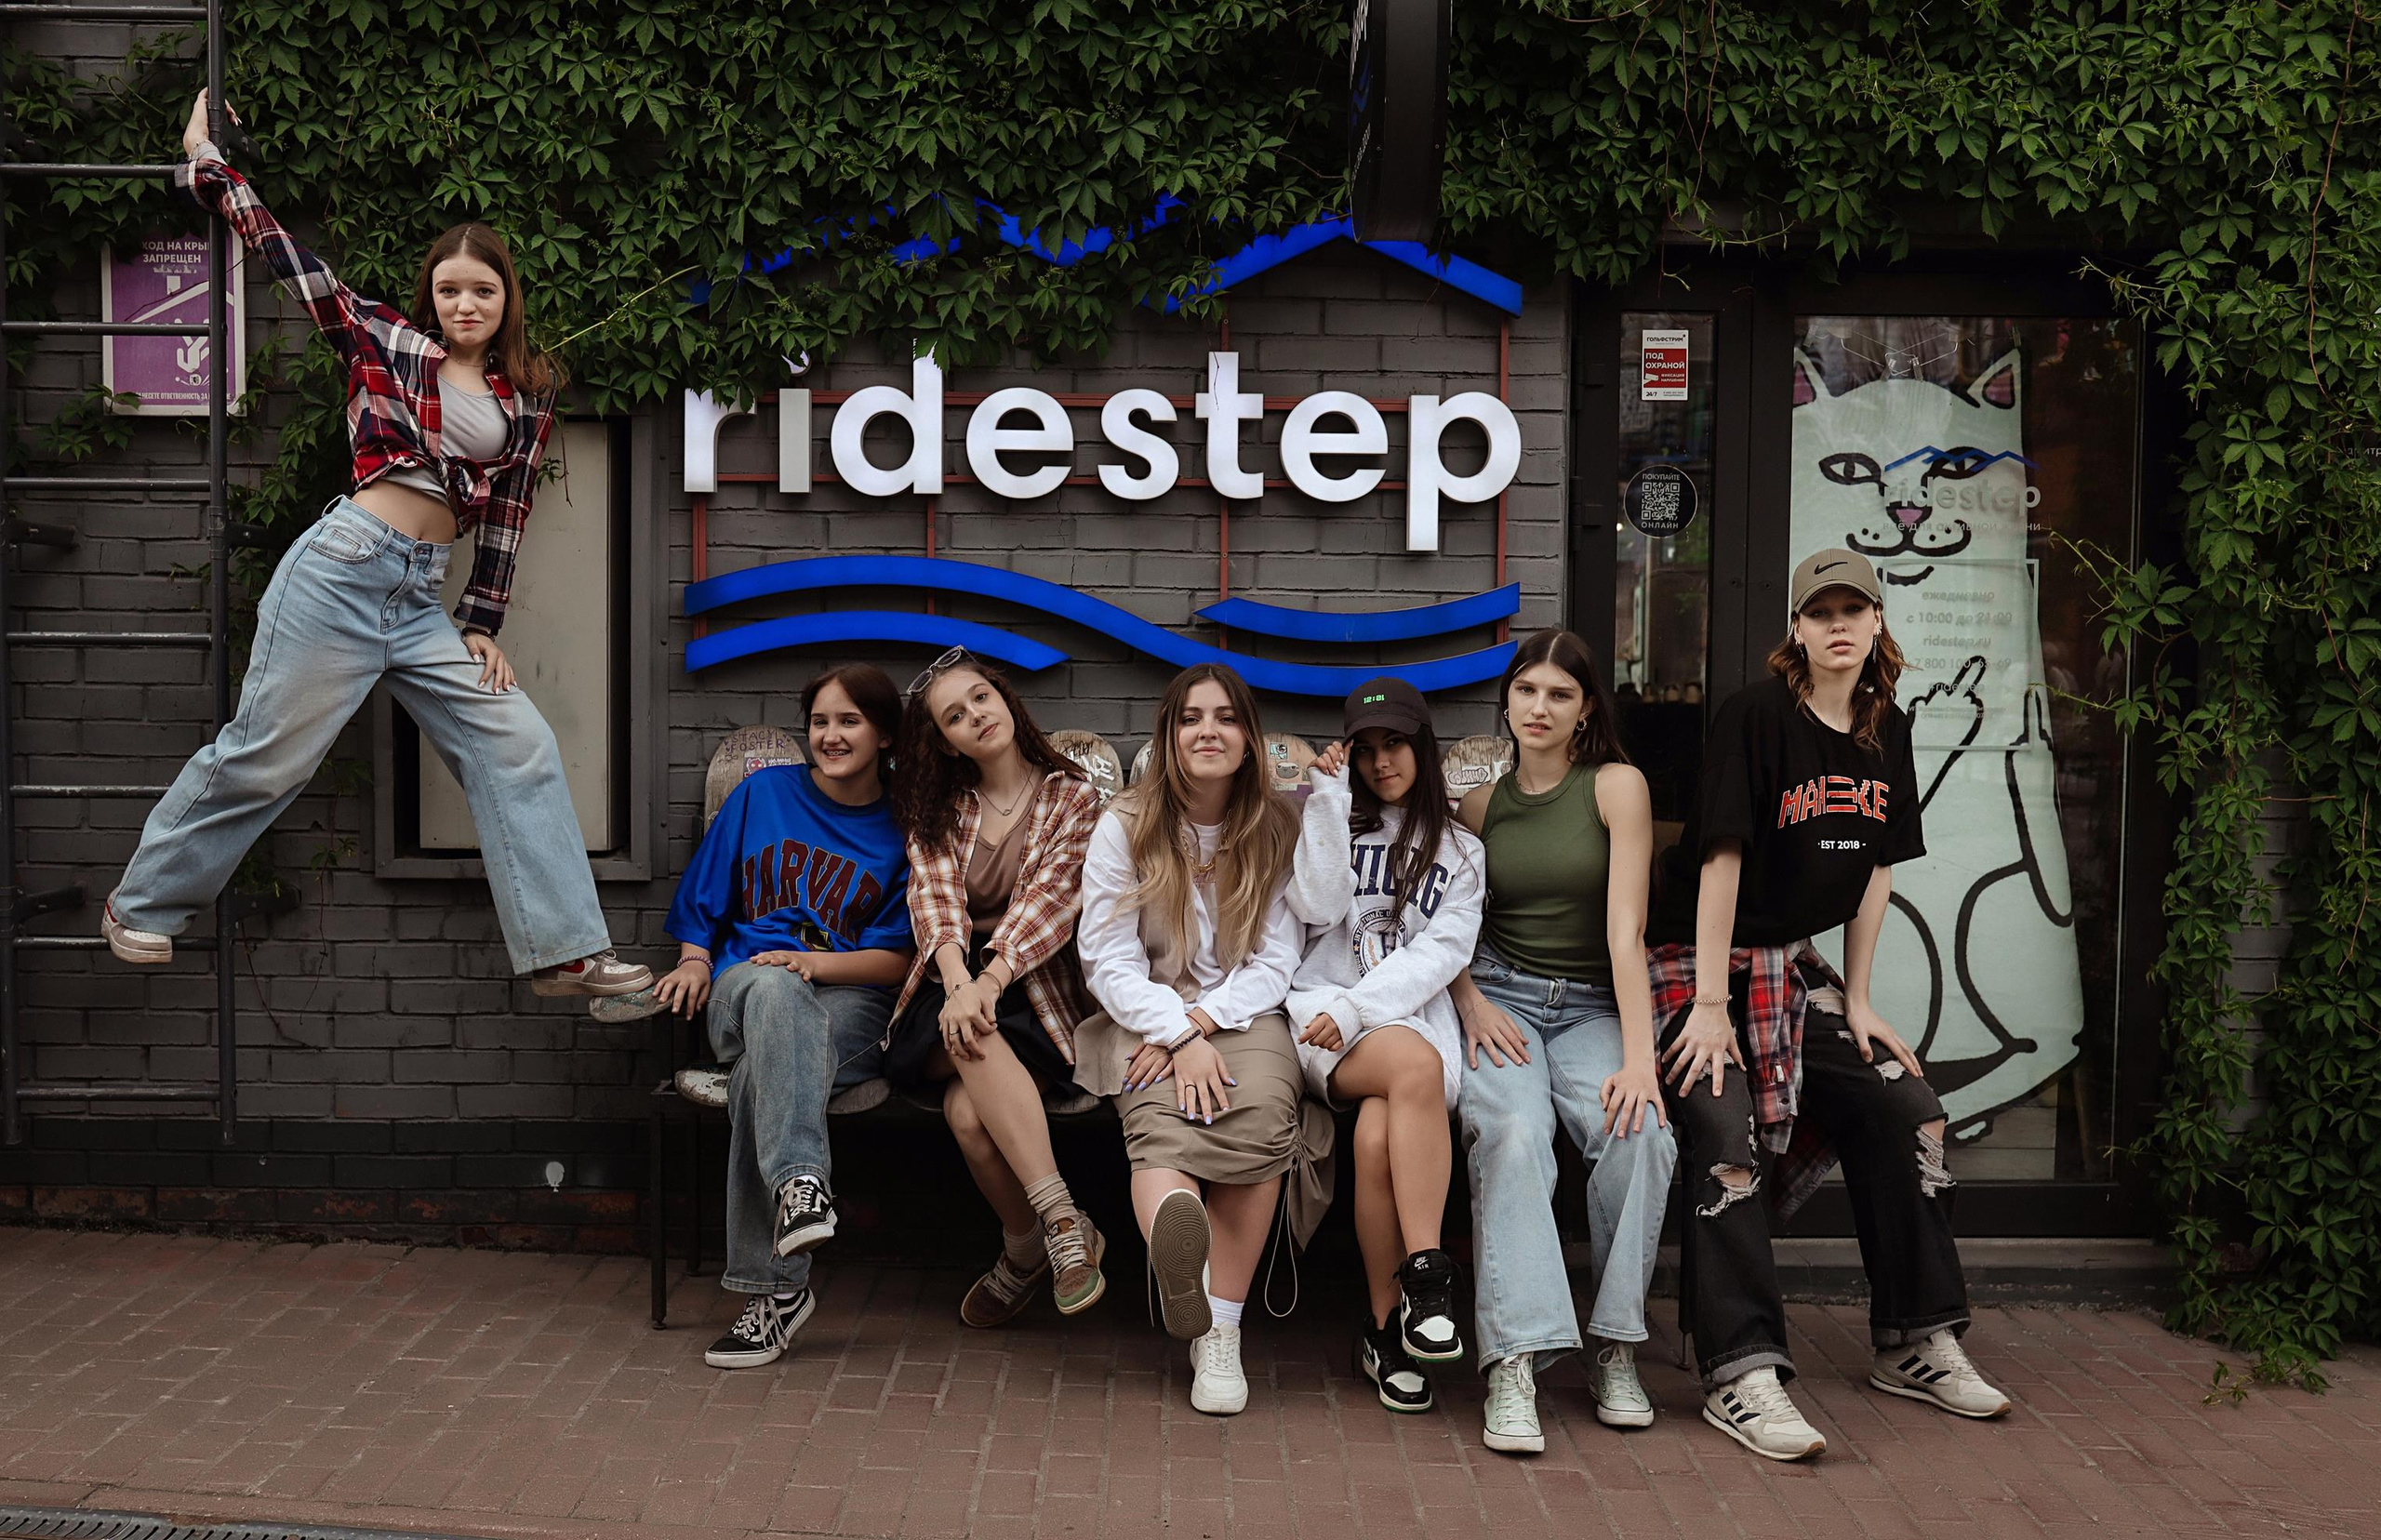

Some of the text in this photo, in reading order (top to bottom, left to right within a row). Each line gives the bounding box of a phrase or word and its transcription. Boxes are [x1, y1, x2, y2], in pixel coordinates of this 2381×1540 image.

[140, 241, 210, 252] ХОД НА КРЫ
[142, 253, 202, 264] ЗАПРЕЩЕН
[1645, 361, 1685, 369] ОХРАНОЙ
[1642, 472, 1681, 481] ПОКУПАЙТЕ
[1883, 476, 2042, 517] ridestep
[1641, 521, 1679, 529] ОНЛАЙН
[1919, 612, 1953, 624] 10:00
[1922, 634, 1991, 649] ridestep.ru
[732, 729, 776, 743] STACY
[730, 738, 785, 752] FOSTER
[1837, 840, 1860, 849] 2018
[742, 838, 883, 947] HARVAR
